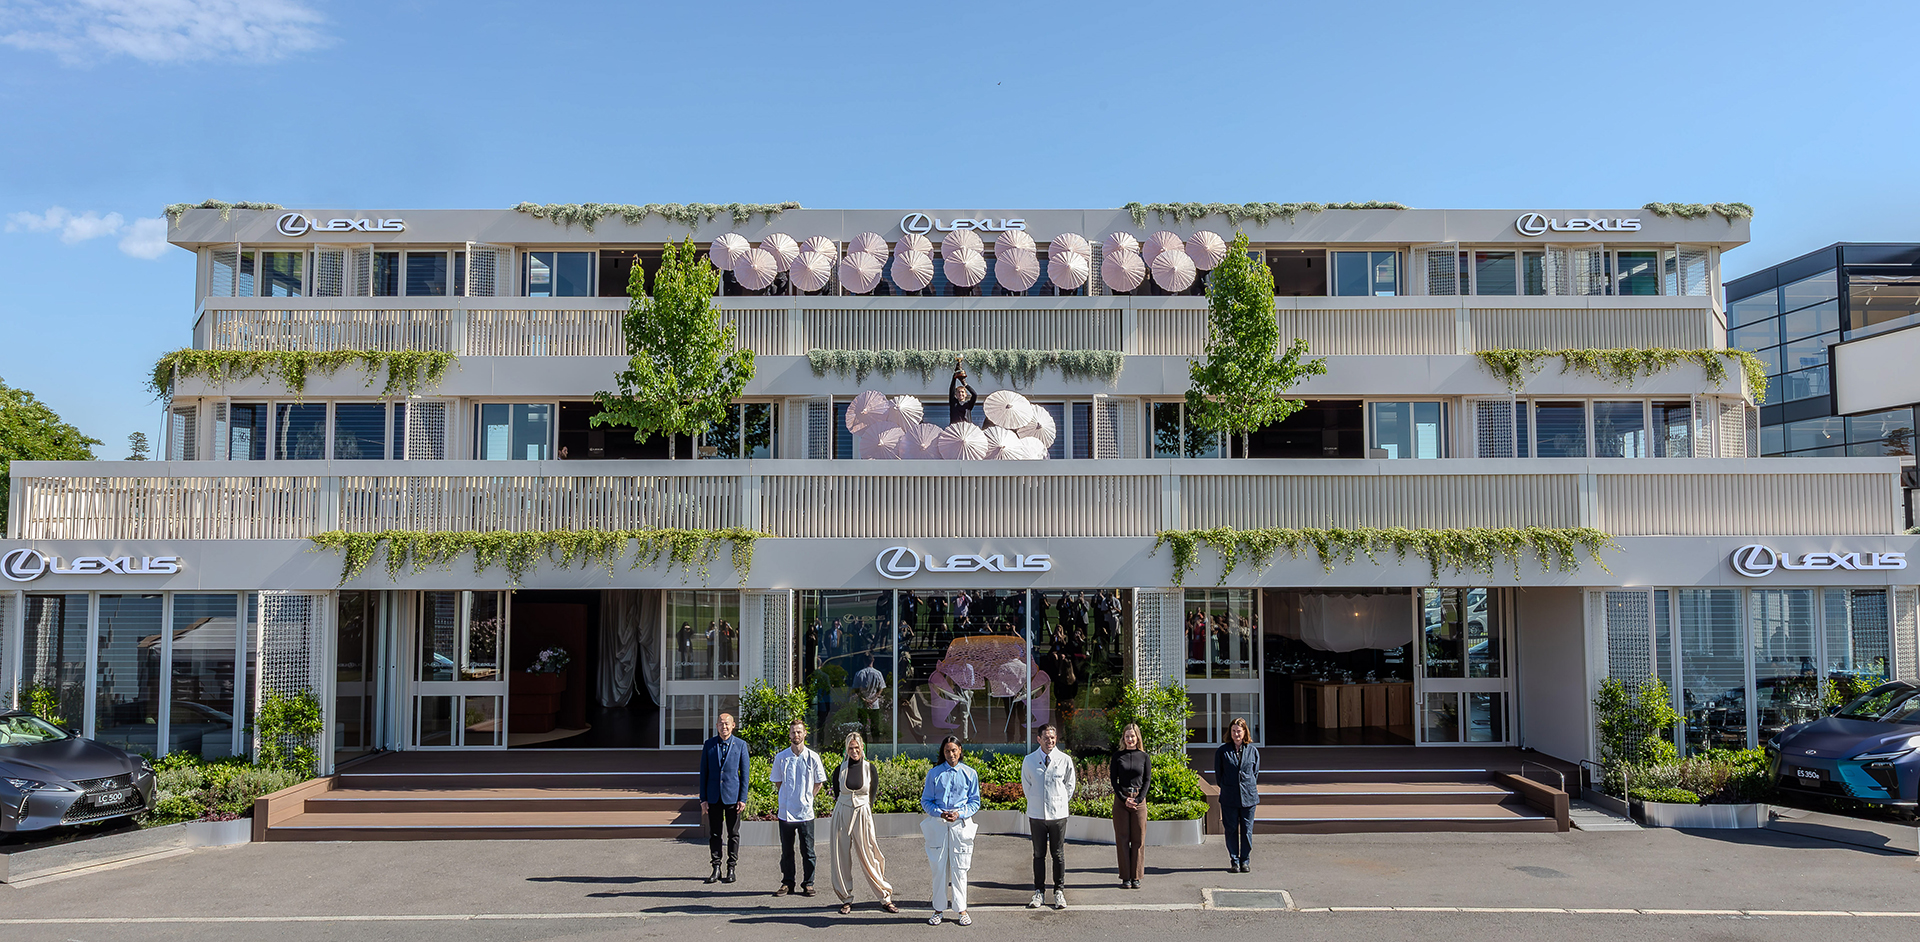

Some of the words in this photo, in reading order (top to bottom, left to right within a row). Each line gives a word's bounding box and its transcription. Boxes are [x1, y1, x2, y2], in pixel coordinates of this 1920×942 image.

[311, 218, 403, 231] LEXUS
[935, 218, 1026, 231] LEXUS
[1551, 218, 1641, 231] LEXUS
[50, 556, 179, 574] LEXUS
[924, 554, 1051, 572] LEXUS
[1781, 553, 1907, 570] LEXUS
[1797, 769, 1804, 777] ES
[98, 794, 107, 803] LC
[108, 792, 123, 801] 500
